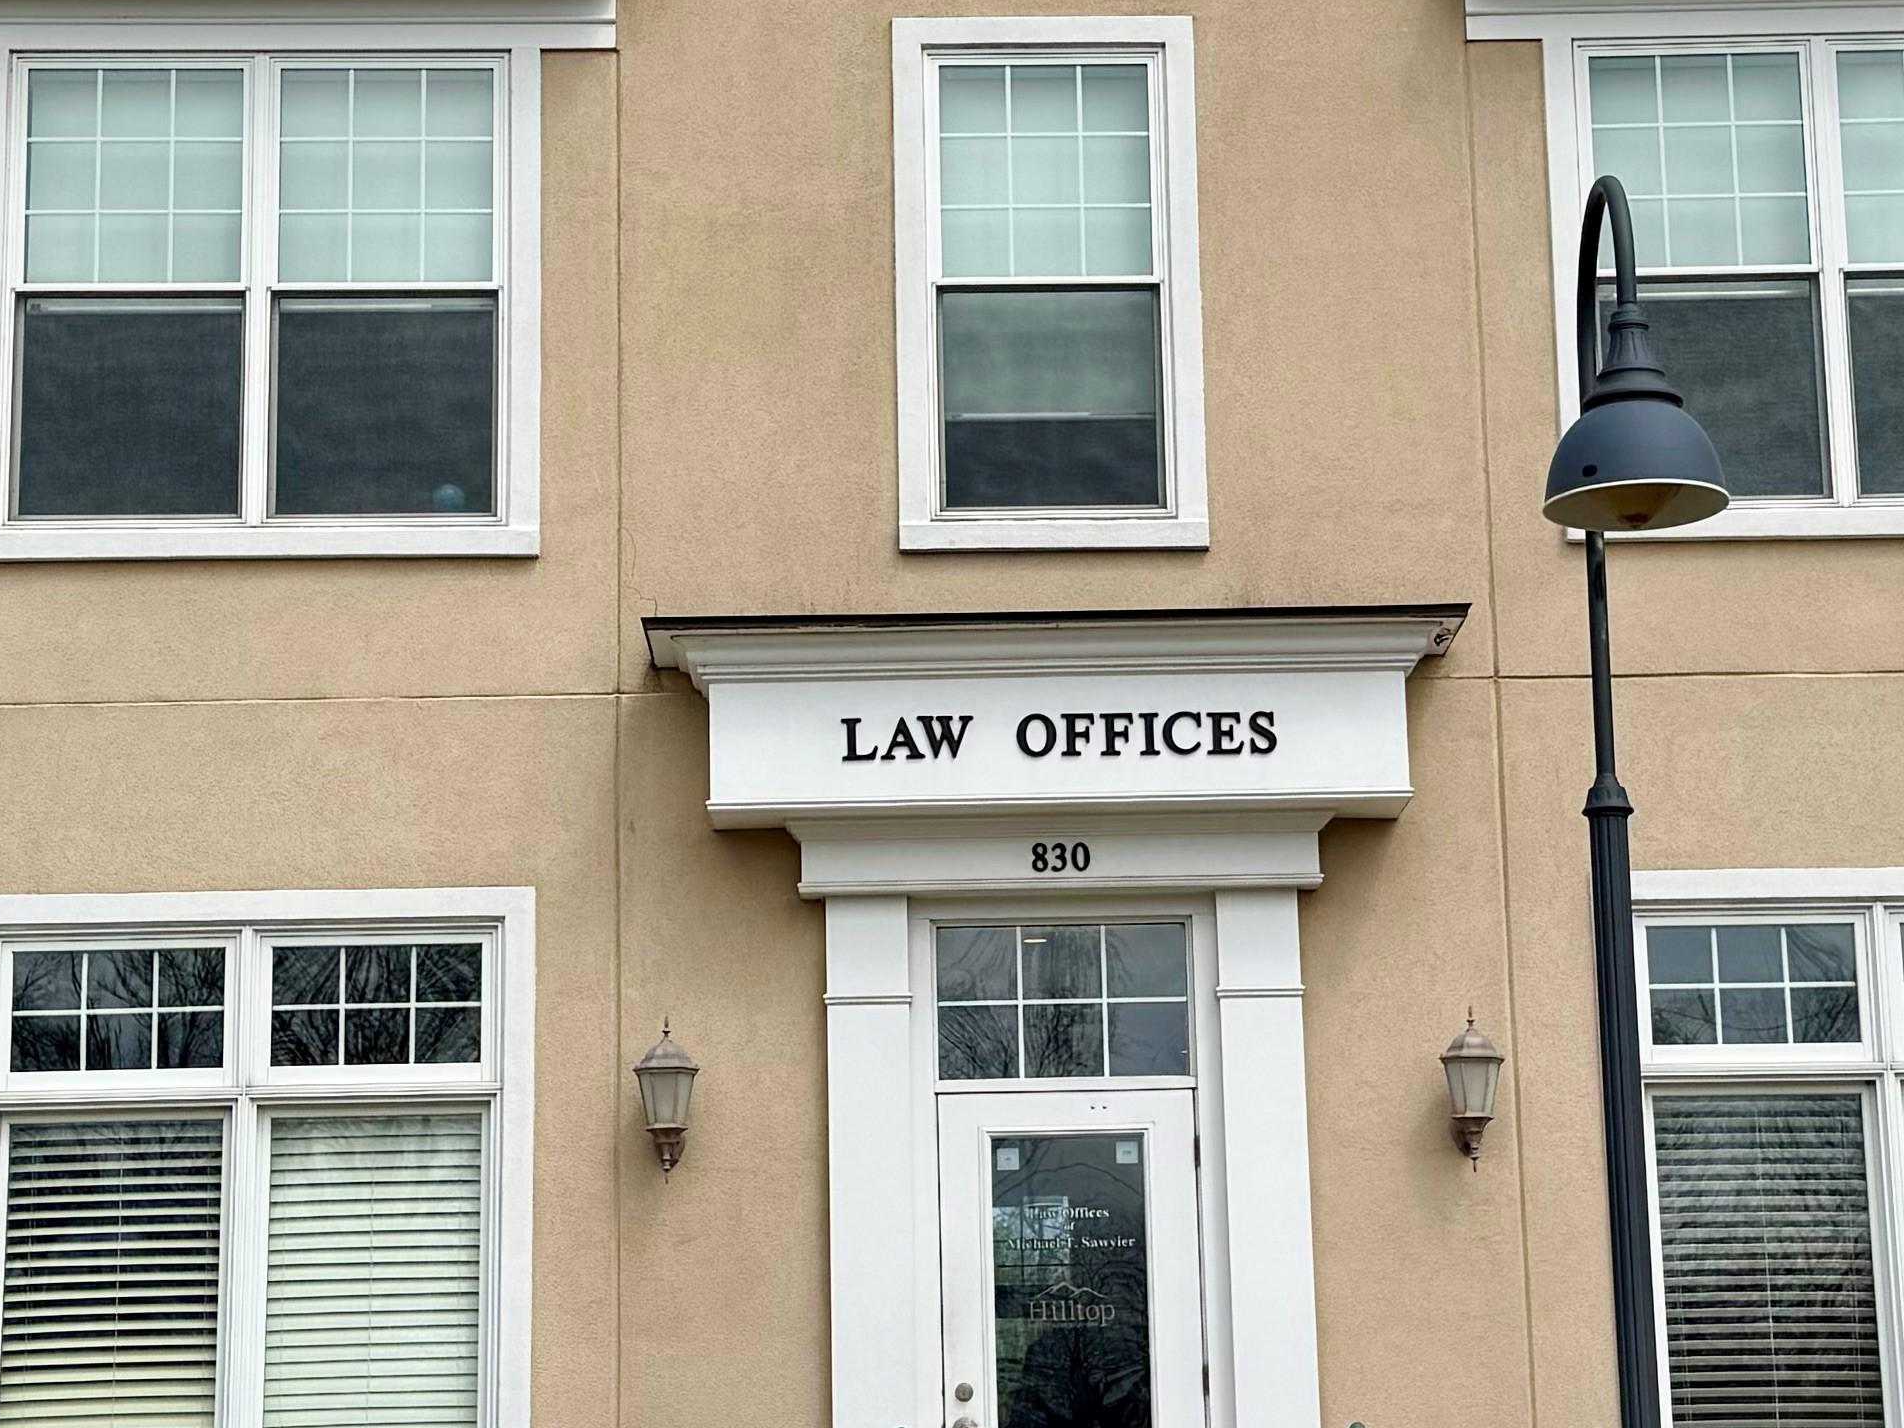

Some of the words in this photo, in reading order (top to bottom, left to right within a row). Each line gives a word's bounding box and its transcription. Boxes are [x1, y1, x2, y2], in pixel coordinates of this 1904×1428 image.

[840, 715, 975, 762] LAW
[1016, 710, 1278, 759] OFFICES
[1030, 841, 1092, 874] 830
[1062, 1207, 1110, 1219] Offices
[1028, 1299, 1116, 1327] Hilltop
